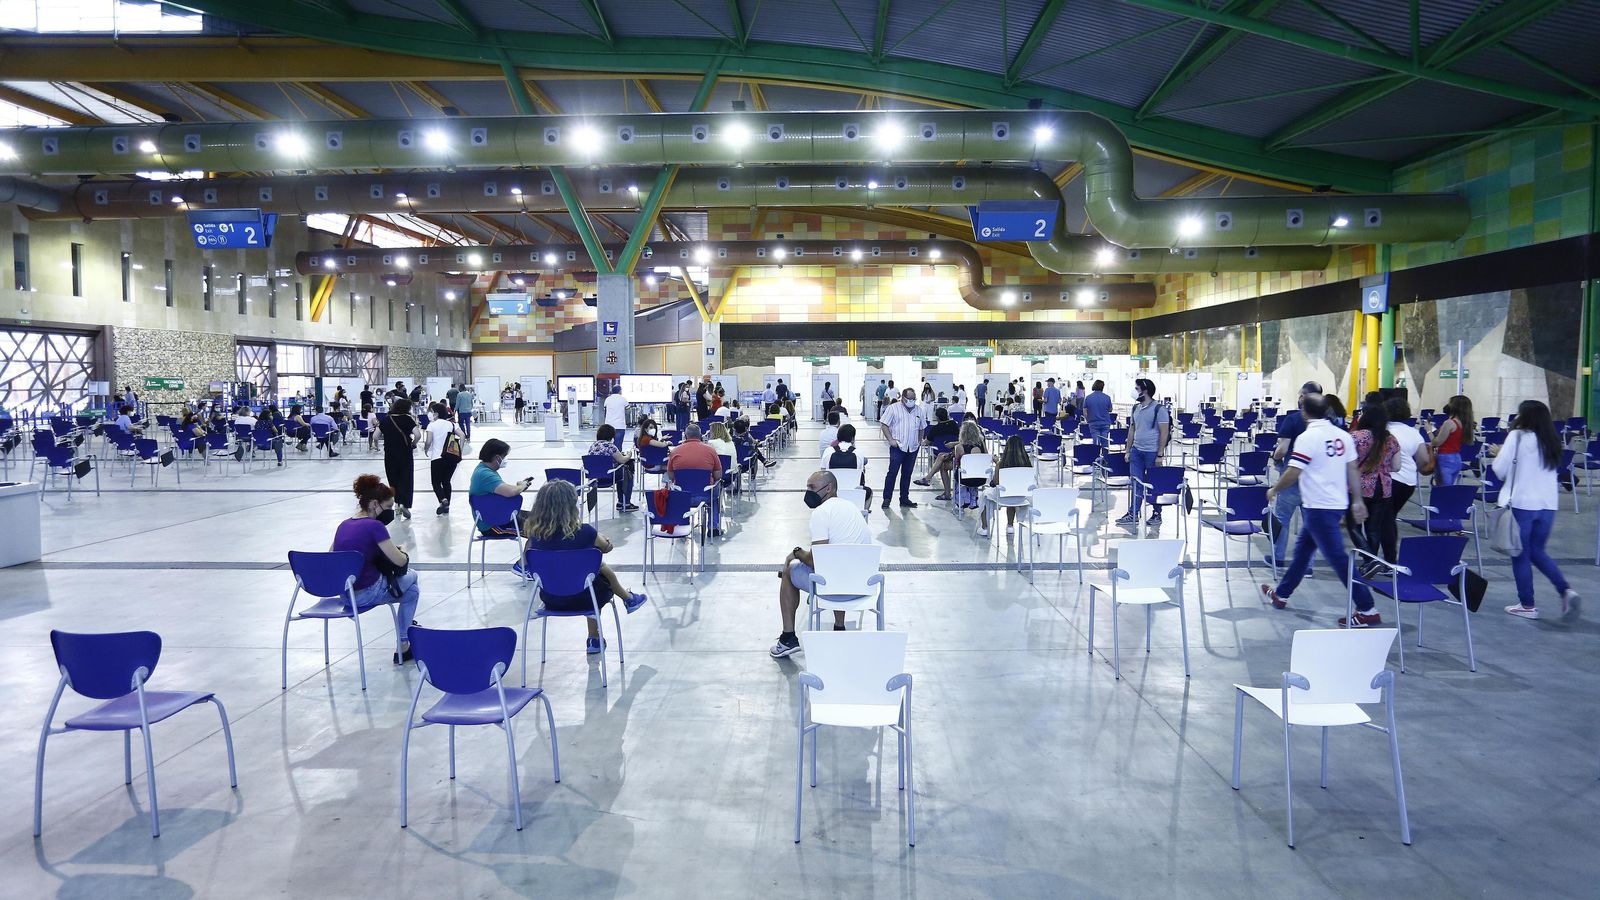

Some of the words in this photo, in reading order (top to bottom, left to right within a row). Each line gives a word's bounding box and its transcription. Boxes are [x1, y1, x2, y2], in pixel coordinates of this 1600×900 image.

[228, 223, 235, 233] 1
[1034, 219, 1047, 237] 2
[244, 226, 258, 245] 2
[517, 303, 525, 313] 2
[629, 382, 664, 393] 14:15
[1325, 438, 1345, 457] 59
